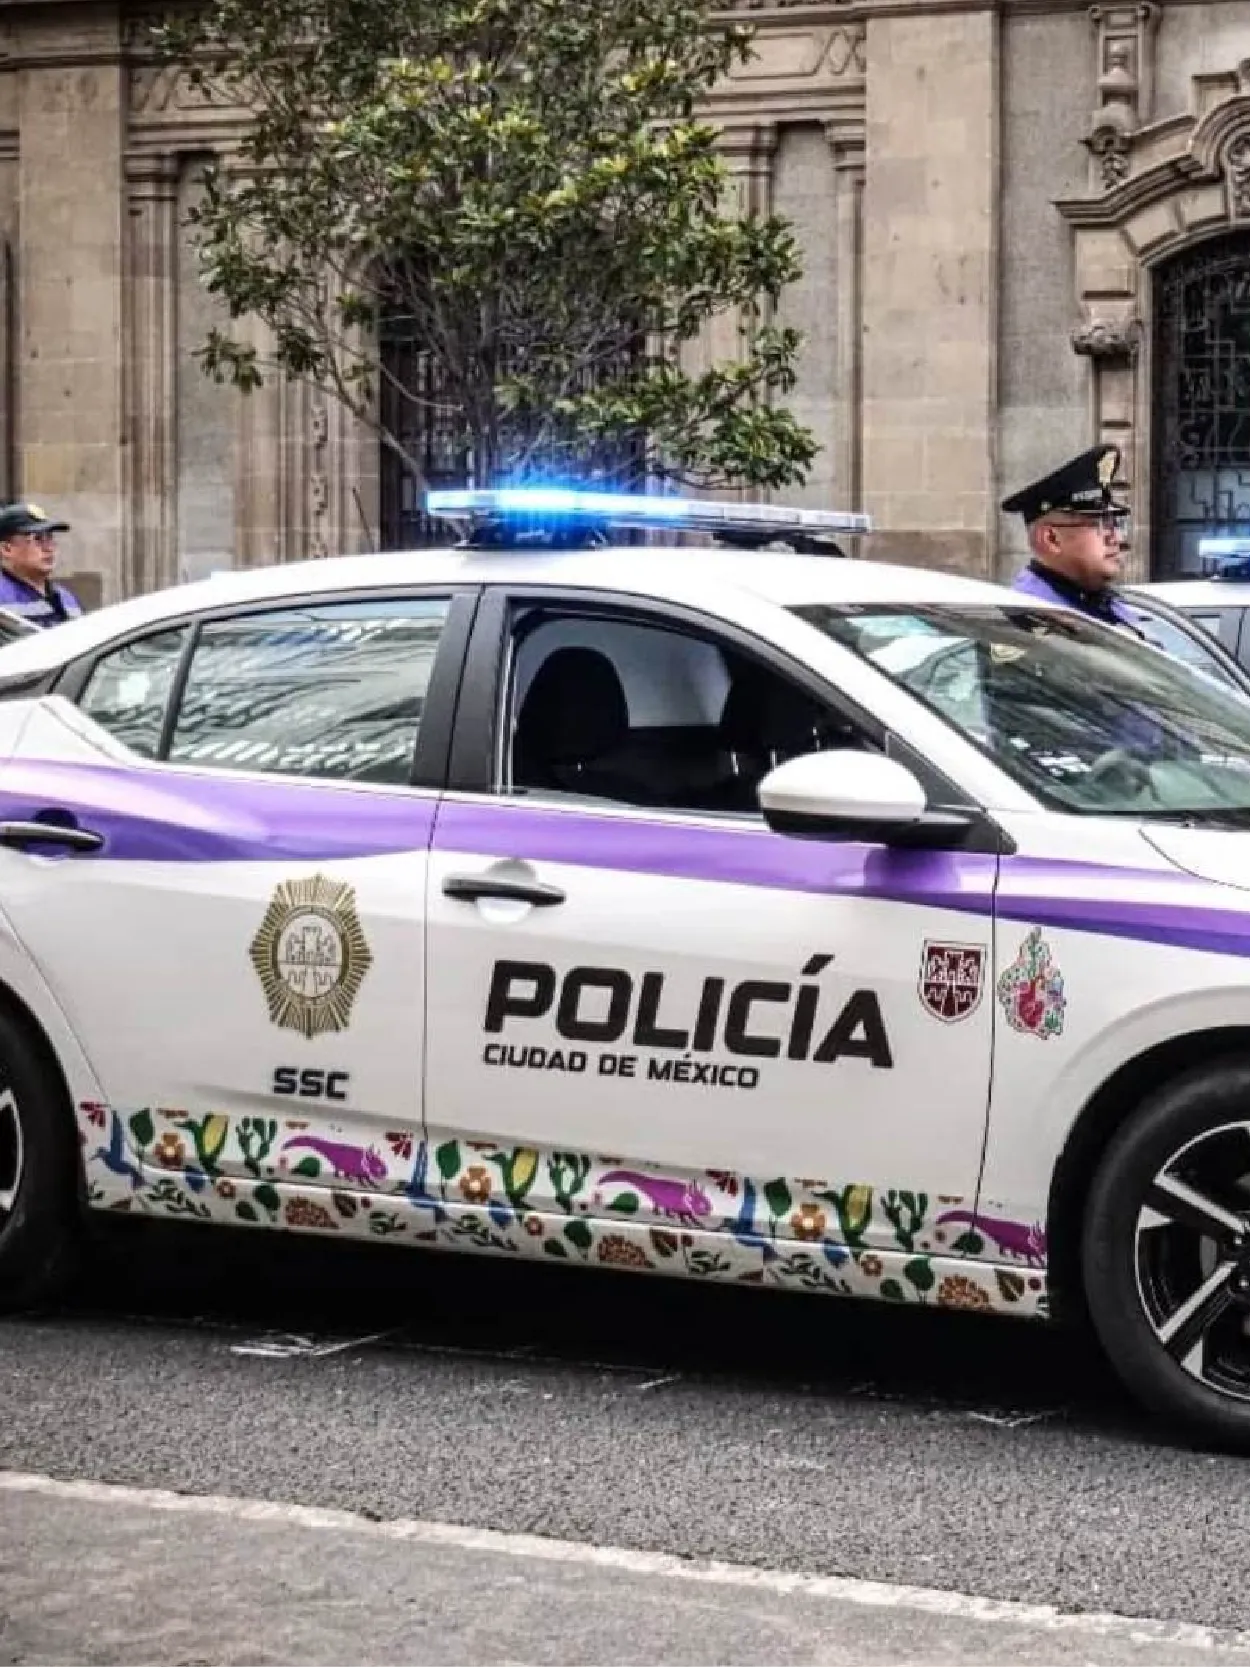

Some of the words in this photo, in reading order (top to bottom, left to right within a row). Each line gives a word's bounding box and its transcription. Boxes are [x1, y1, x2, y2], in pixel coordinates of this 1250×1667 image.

[485, 953, 893, 1068] POLICÍA
[274, 1067, 349, 1100] SSC
[484, 1043, 586, 1072] CIUDAD
[599, 1054, 638, 1077] DE
[647, 1053, 759, 1089] MÉXICO
